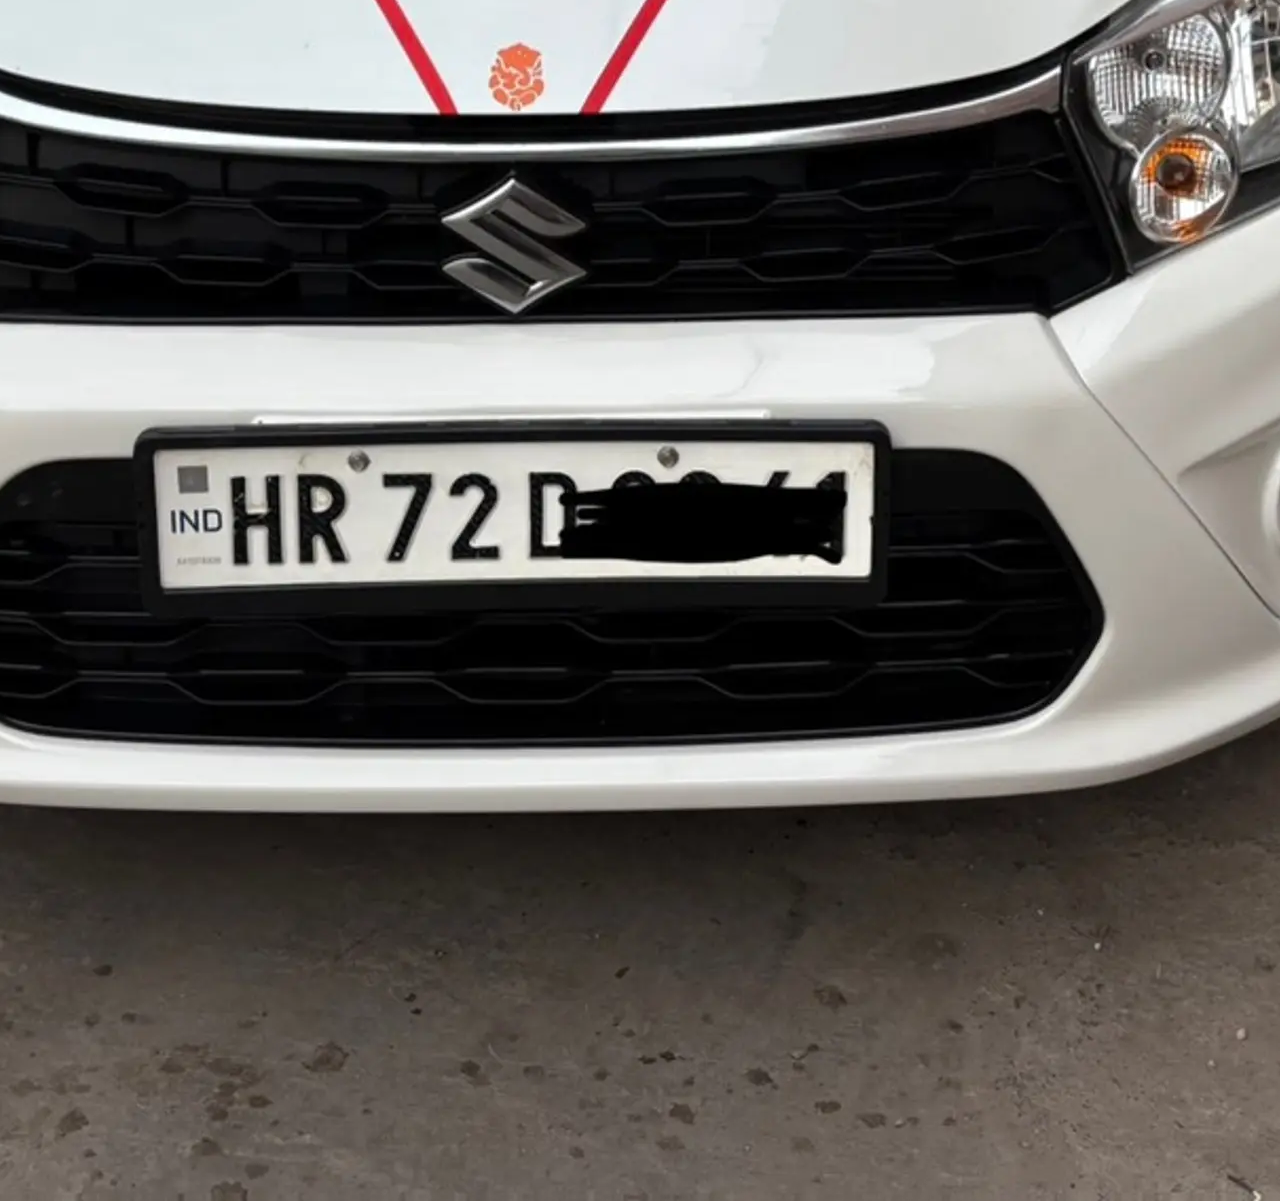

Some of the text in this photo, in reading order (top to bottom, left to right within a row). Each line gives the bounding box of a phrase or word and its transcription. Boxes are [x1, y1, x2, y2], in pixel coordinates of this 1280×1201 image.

[170, 509, 223, 534] IND
[230, 475, 348, 566] HR
[382, 473, 501, 562] 72
